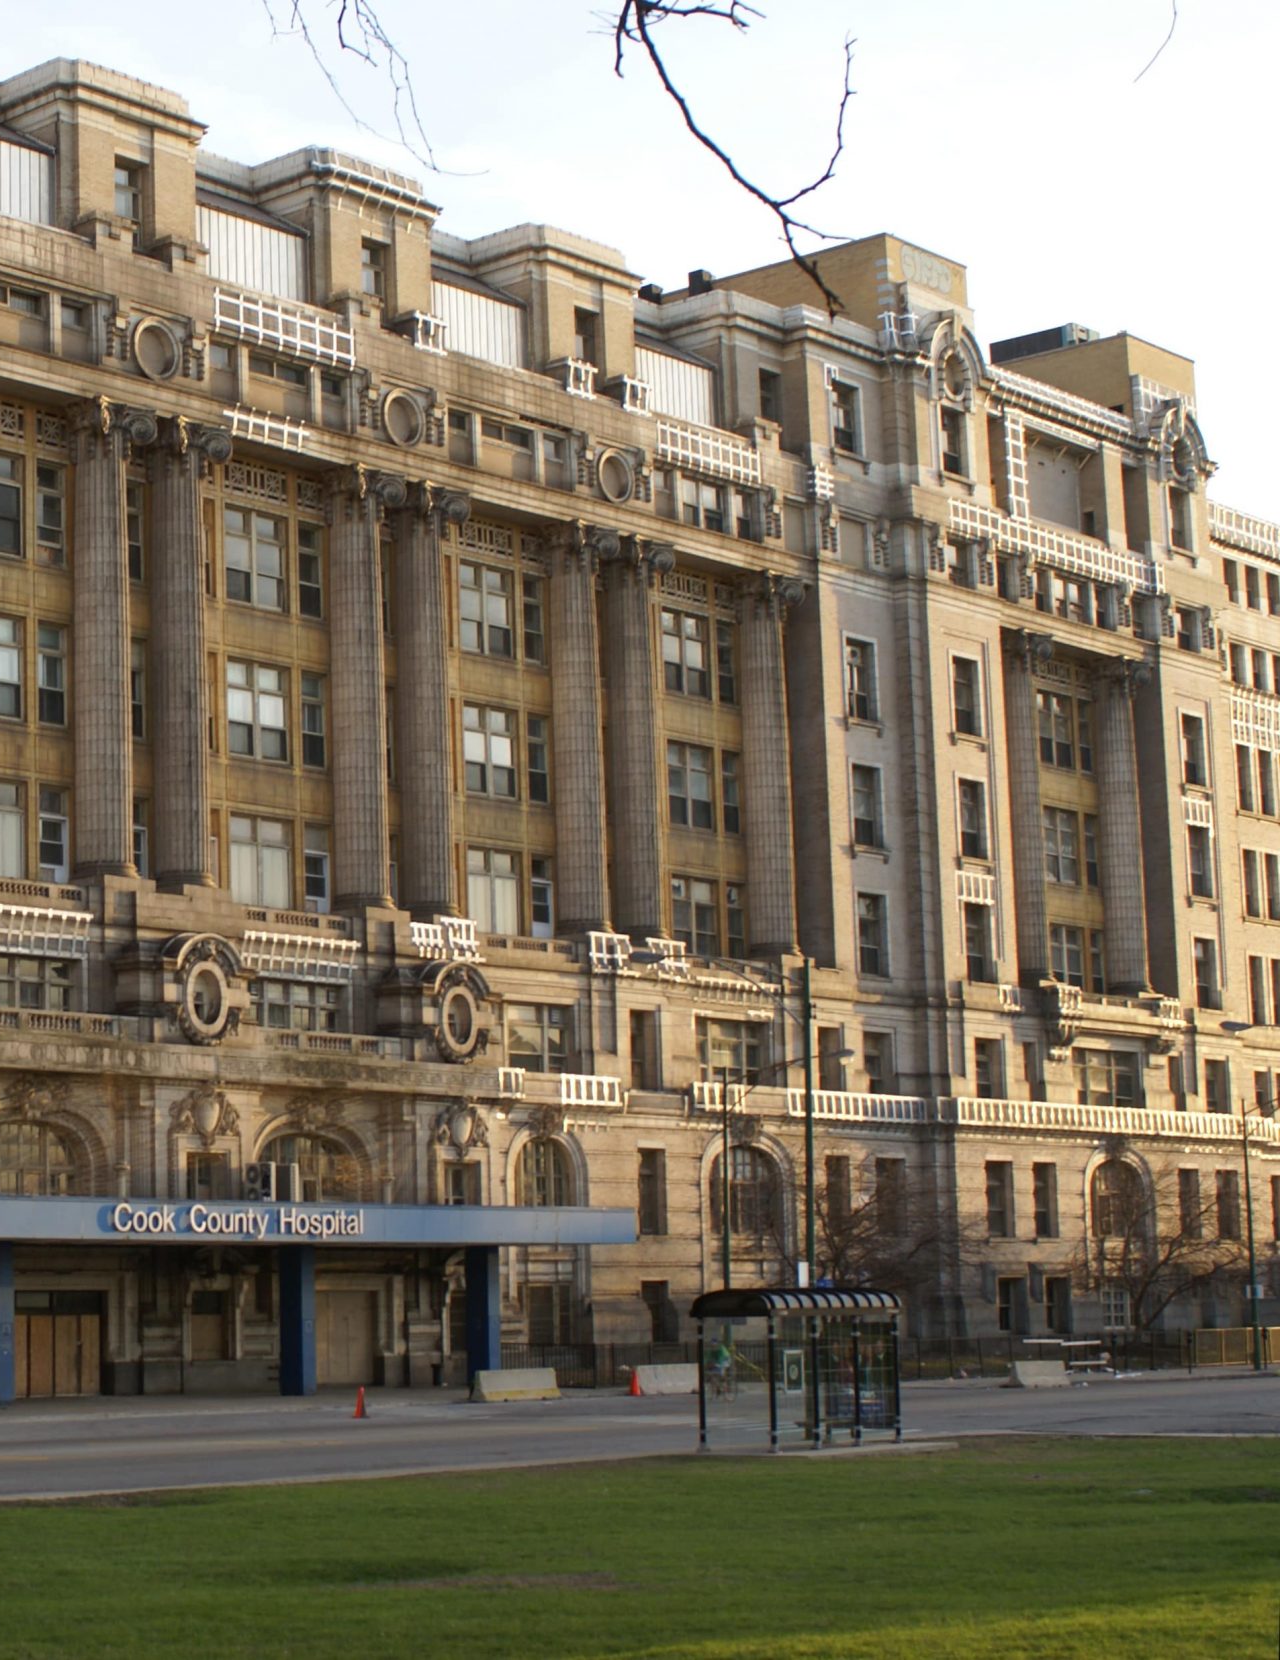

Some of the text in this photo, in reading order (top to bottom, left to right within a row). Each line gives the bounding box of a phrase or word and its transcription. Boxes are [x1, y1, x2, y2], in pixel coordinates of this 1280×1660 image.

[114, 1203, 364, 1239] Cook County Hospital
